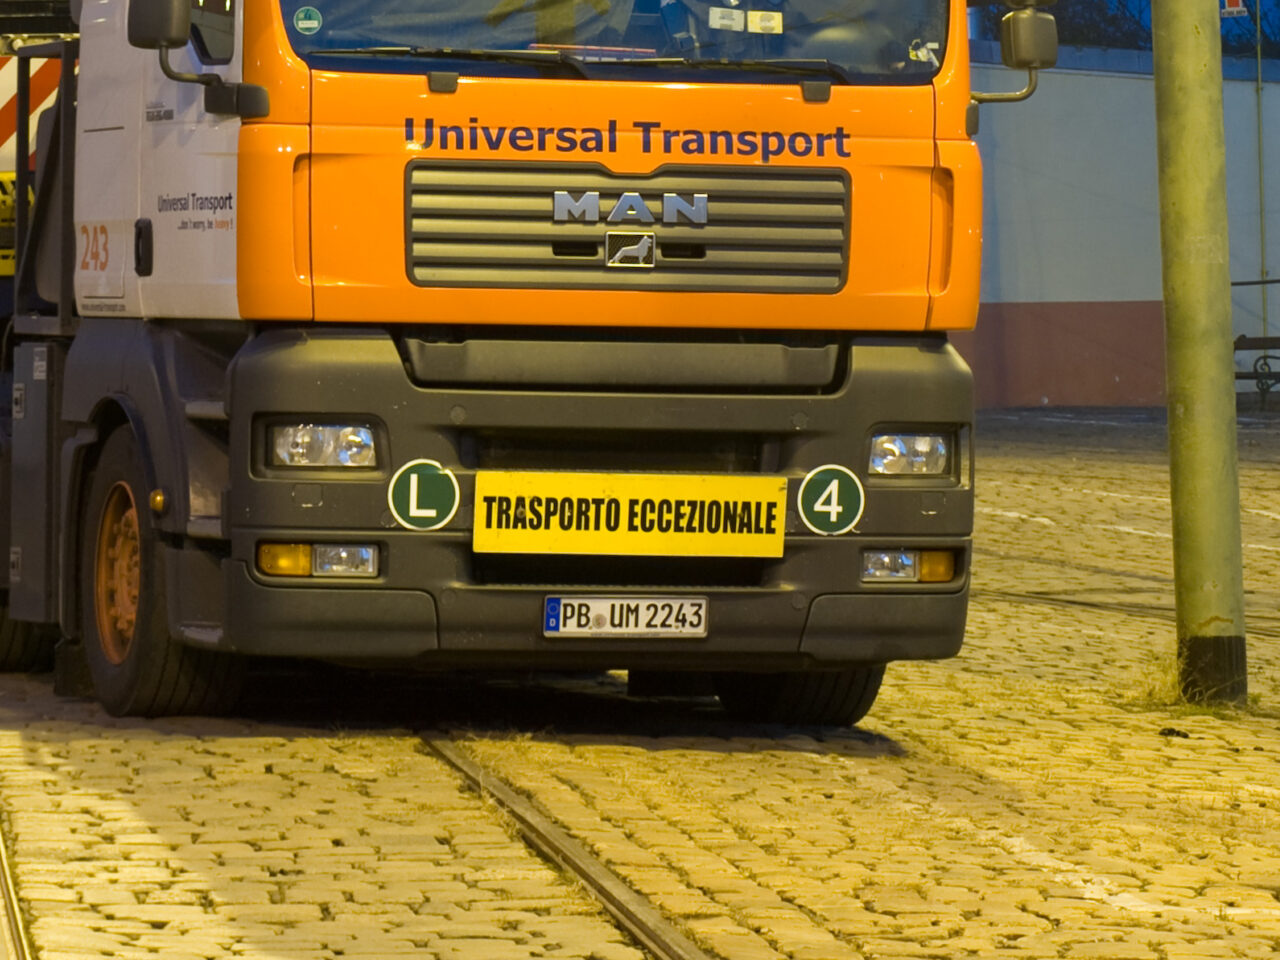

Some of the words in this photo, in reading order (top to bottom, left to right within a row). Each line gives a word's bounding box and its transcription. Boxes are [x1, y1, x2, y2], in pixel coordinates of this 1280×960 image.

[404, 117, 617, 154] Universal
[632, 121, 852, 163] Transport
[157, 193, 189, 212] Universal
[191, 192, 233, 214] Transport
[553, 190, 709, 224] MAN
[80, 224, 109, 271] 243
[408, 472, 437, 517] L
[482, 495, 621, 533] TRASPORTO
[627, 497, 778, 535] ECCEZIONALE
[813, 478, 844, 523] 4
[562, 603, 591, 628] PB
[610, 603, 640, 628] UM
[645, 603, 704, 628] 2243
